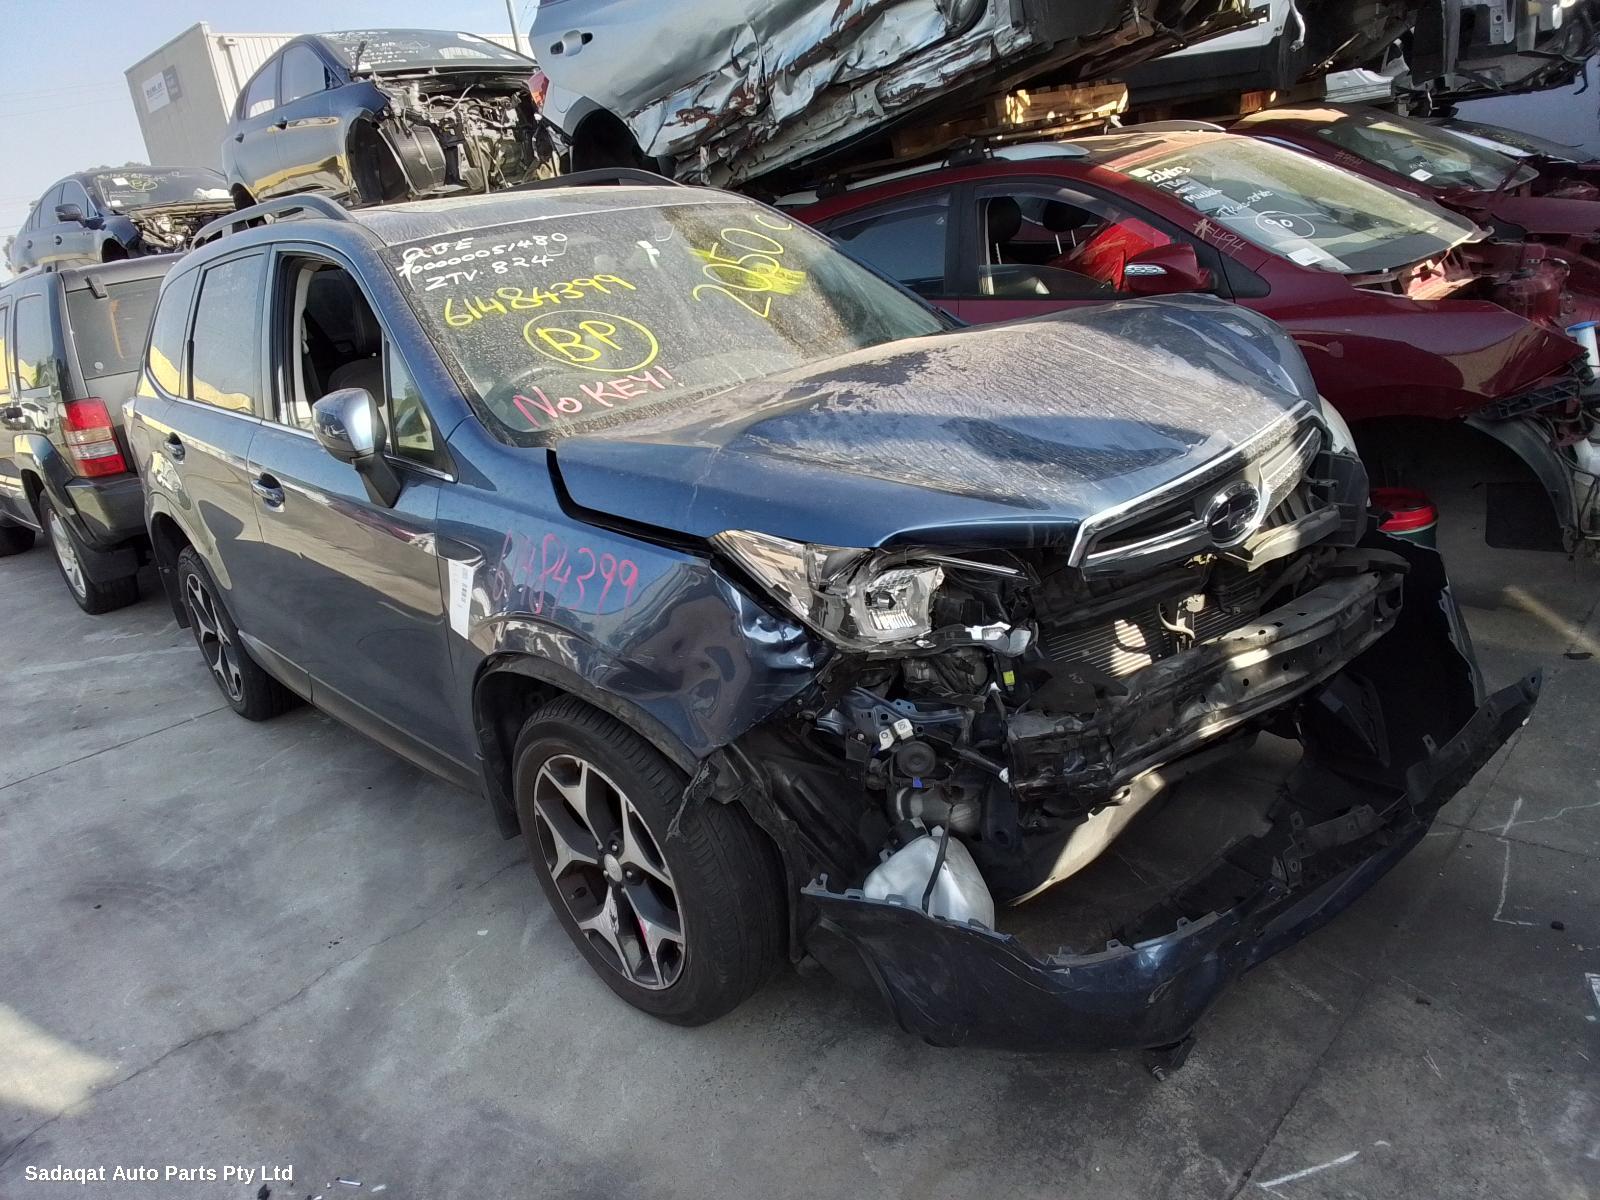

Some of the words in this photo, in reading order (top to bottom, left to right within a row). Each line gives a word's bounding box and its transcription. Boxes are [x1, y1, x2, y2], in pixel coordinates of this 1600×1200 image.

[444, 273, 637, 327] 61484399
[535, 319, 623, 362] BP
[512, 385, 583, 428] No
